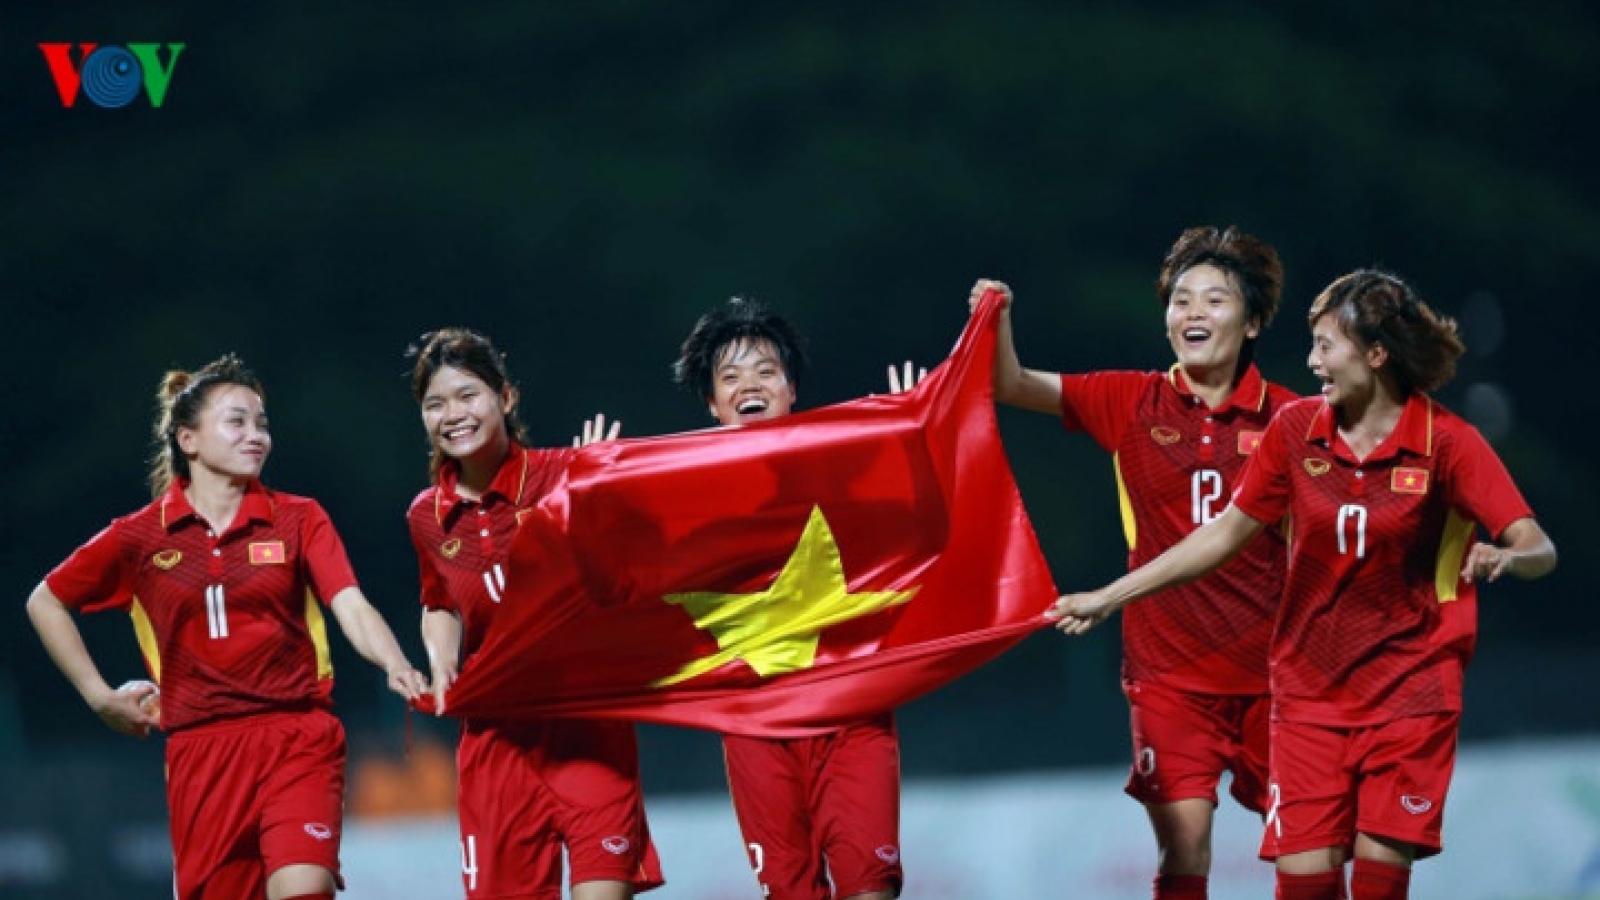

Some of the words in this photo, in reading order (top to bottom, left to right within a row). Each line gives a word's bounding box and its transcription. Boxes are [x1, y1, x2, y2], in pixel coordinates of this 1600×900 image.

[1191, 469, 1222, 525] 12
[1337, 503, 1367, 558] 17
[205, 584, 229, 639] 11
